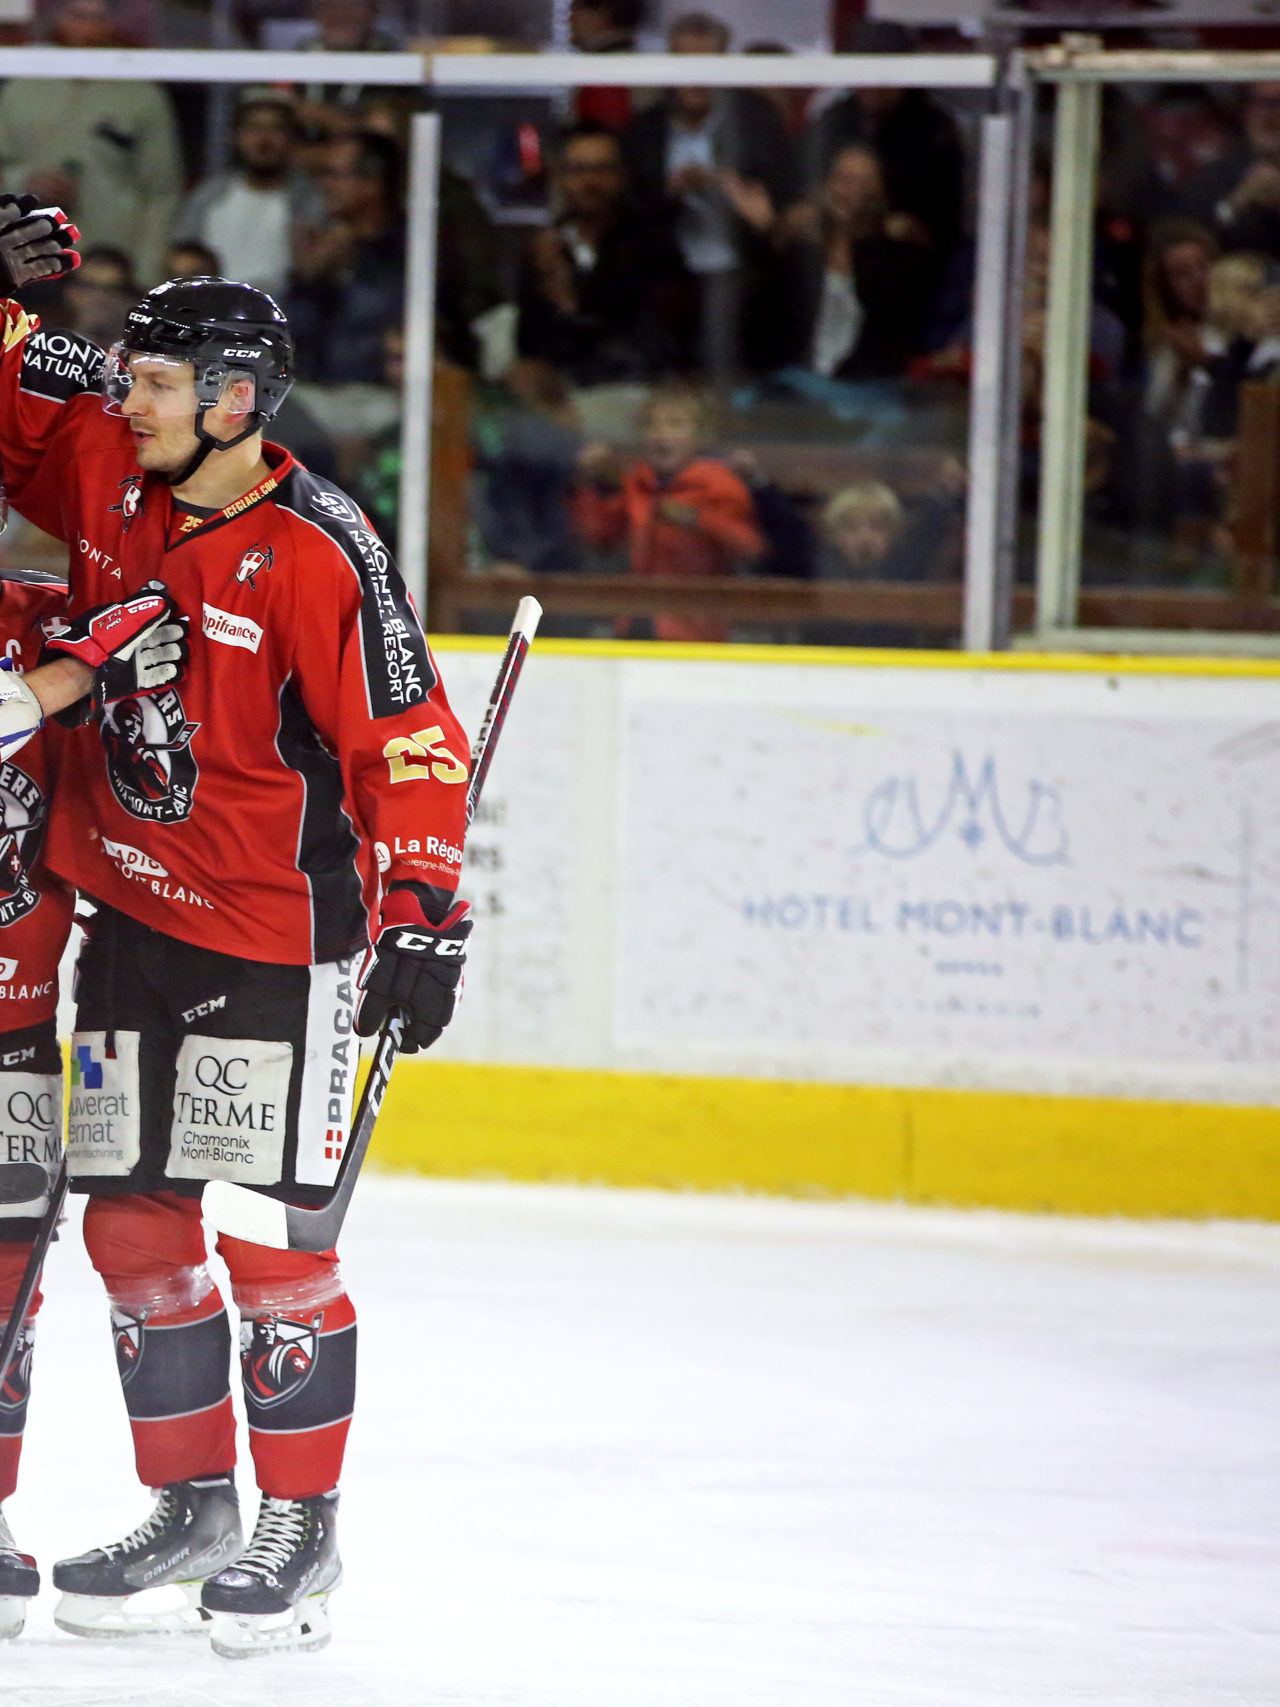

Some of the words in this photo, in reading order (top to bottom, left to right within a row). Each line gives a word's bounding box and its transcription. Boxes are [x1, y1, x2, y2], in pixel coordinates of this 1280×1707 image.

[128, 312, 152, 324] CCM
[22, 349, 89, 387] NATURA
[223, 348, 261, 359] CCM
[223, 477, 279, 519] ICEGLACE.COM
[128, 599, 160, 614] CCM
[359, 529, 423, 704] MONT-BLANC
[380, 622, 405, 705] RESORT
[382, 725, 470, 785] 25
[394, 836, 420, 854] La
[426, 835, 463, 864] Régio
[742, 893, 882, 936] HOTEL
[895, 899, 1204, 949] MONT-BLANC
[181, 995, 227, 1024] CCM
[195, 1055, 250, 1097] QC
[7, 1091, 55, 1132] QC
[177, 1092, 276, 1132] TERME
[180, 1146, 255, 1165] Mont-Blanc
[183, 1131, 251, 1150] Chamonix
